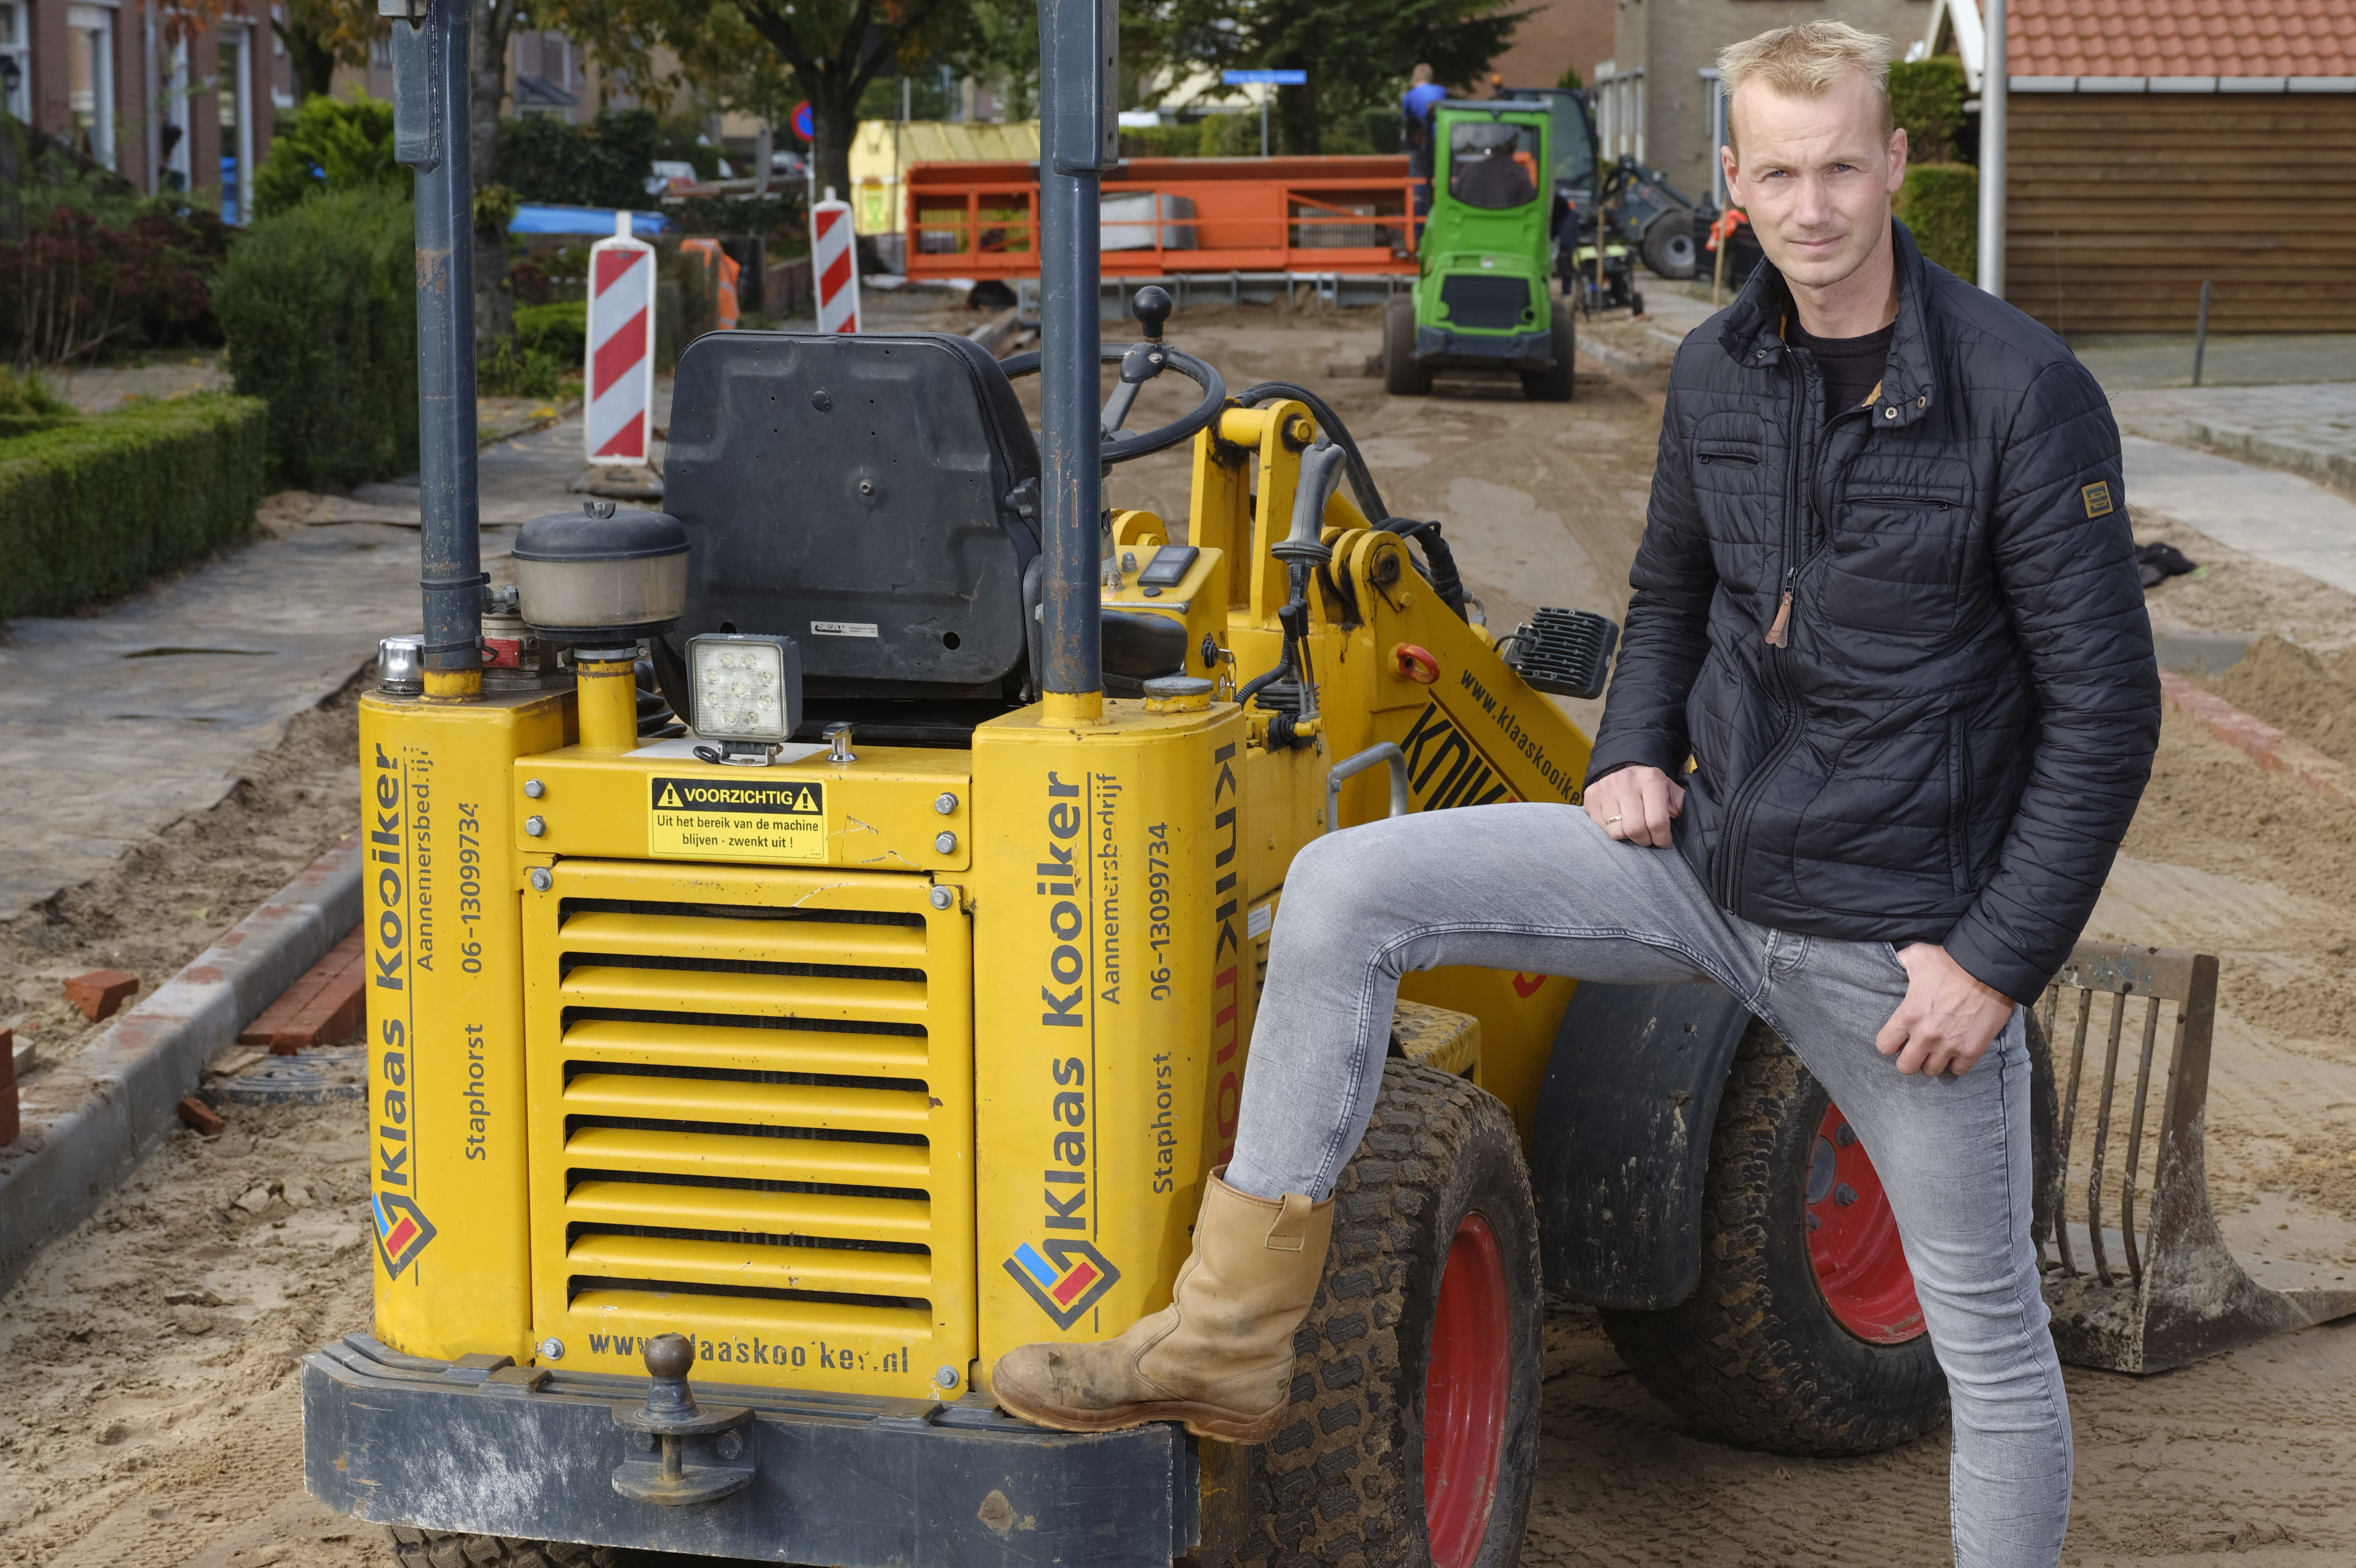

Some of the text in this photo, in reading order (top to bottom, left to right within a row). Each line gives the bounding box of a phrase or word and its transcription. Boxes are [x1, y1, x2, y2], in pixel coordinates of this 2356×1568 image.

[684, 787, 793, 805] VOORZICHTIG
[1460, 669, 1584, 806] www.klaaskooike
[410, 748, 434, 971] Aannemersbedij
[458, 803, 482, 973] 06-13099734
[657, 815, 819, 832] Uit het bereik van de machine
[683, 833, 718, 848] blijven
[729, 836, 768, 848] zwenkt
[772, 837, 787, 848] uit
[1096, 773, 1122, 1005] Aannemersbedrijf
[372, 743, 407, 1186] Klaas Kooiker
[1149, 822, 1171, 1001] 06-13099734
[1037, 771, 1086, 1230] Klaas Kooiker
[463, 1024, 490, 1161] Staphorst
[1151, 1051, 1178, 1194] Staphorst
[589, 1332, 909, 1374] wwlaaskooke.nl
